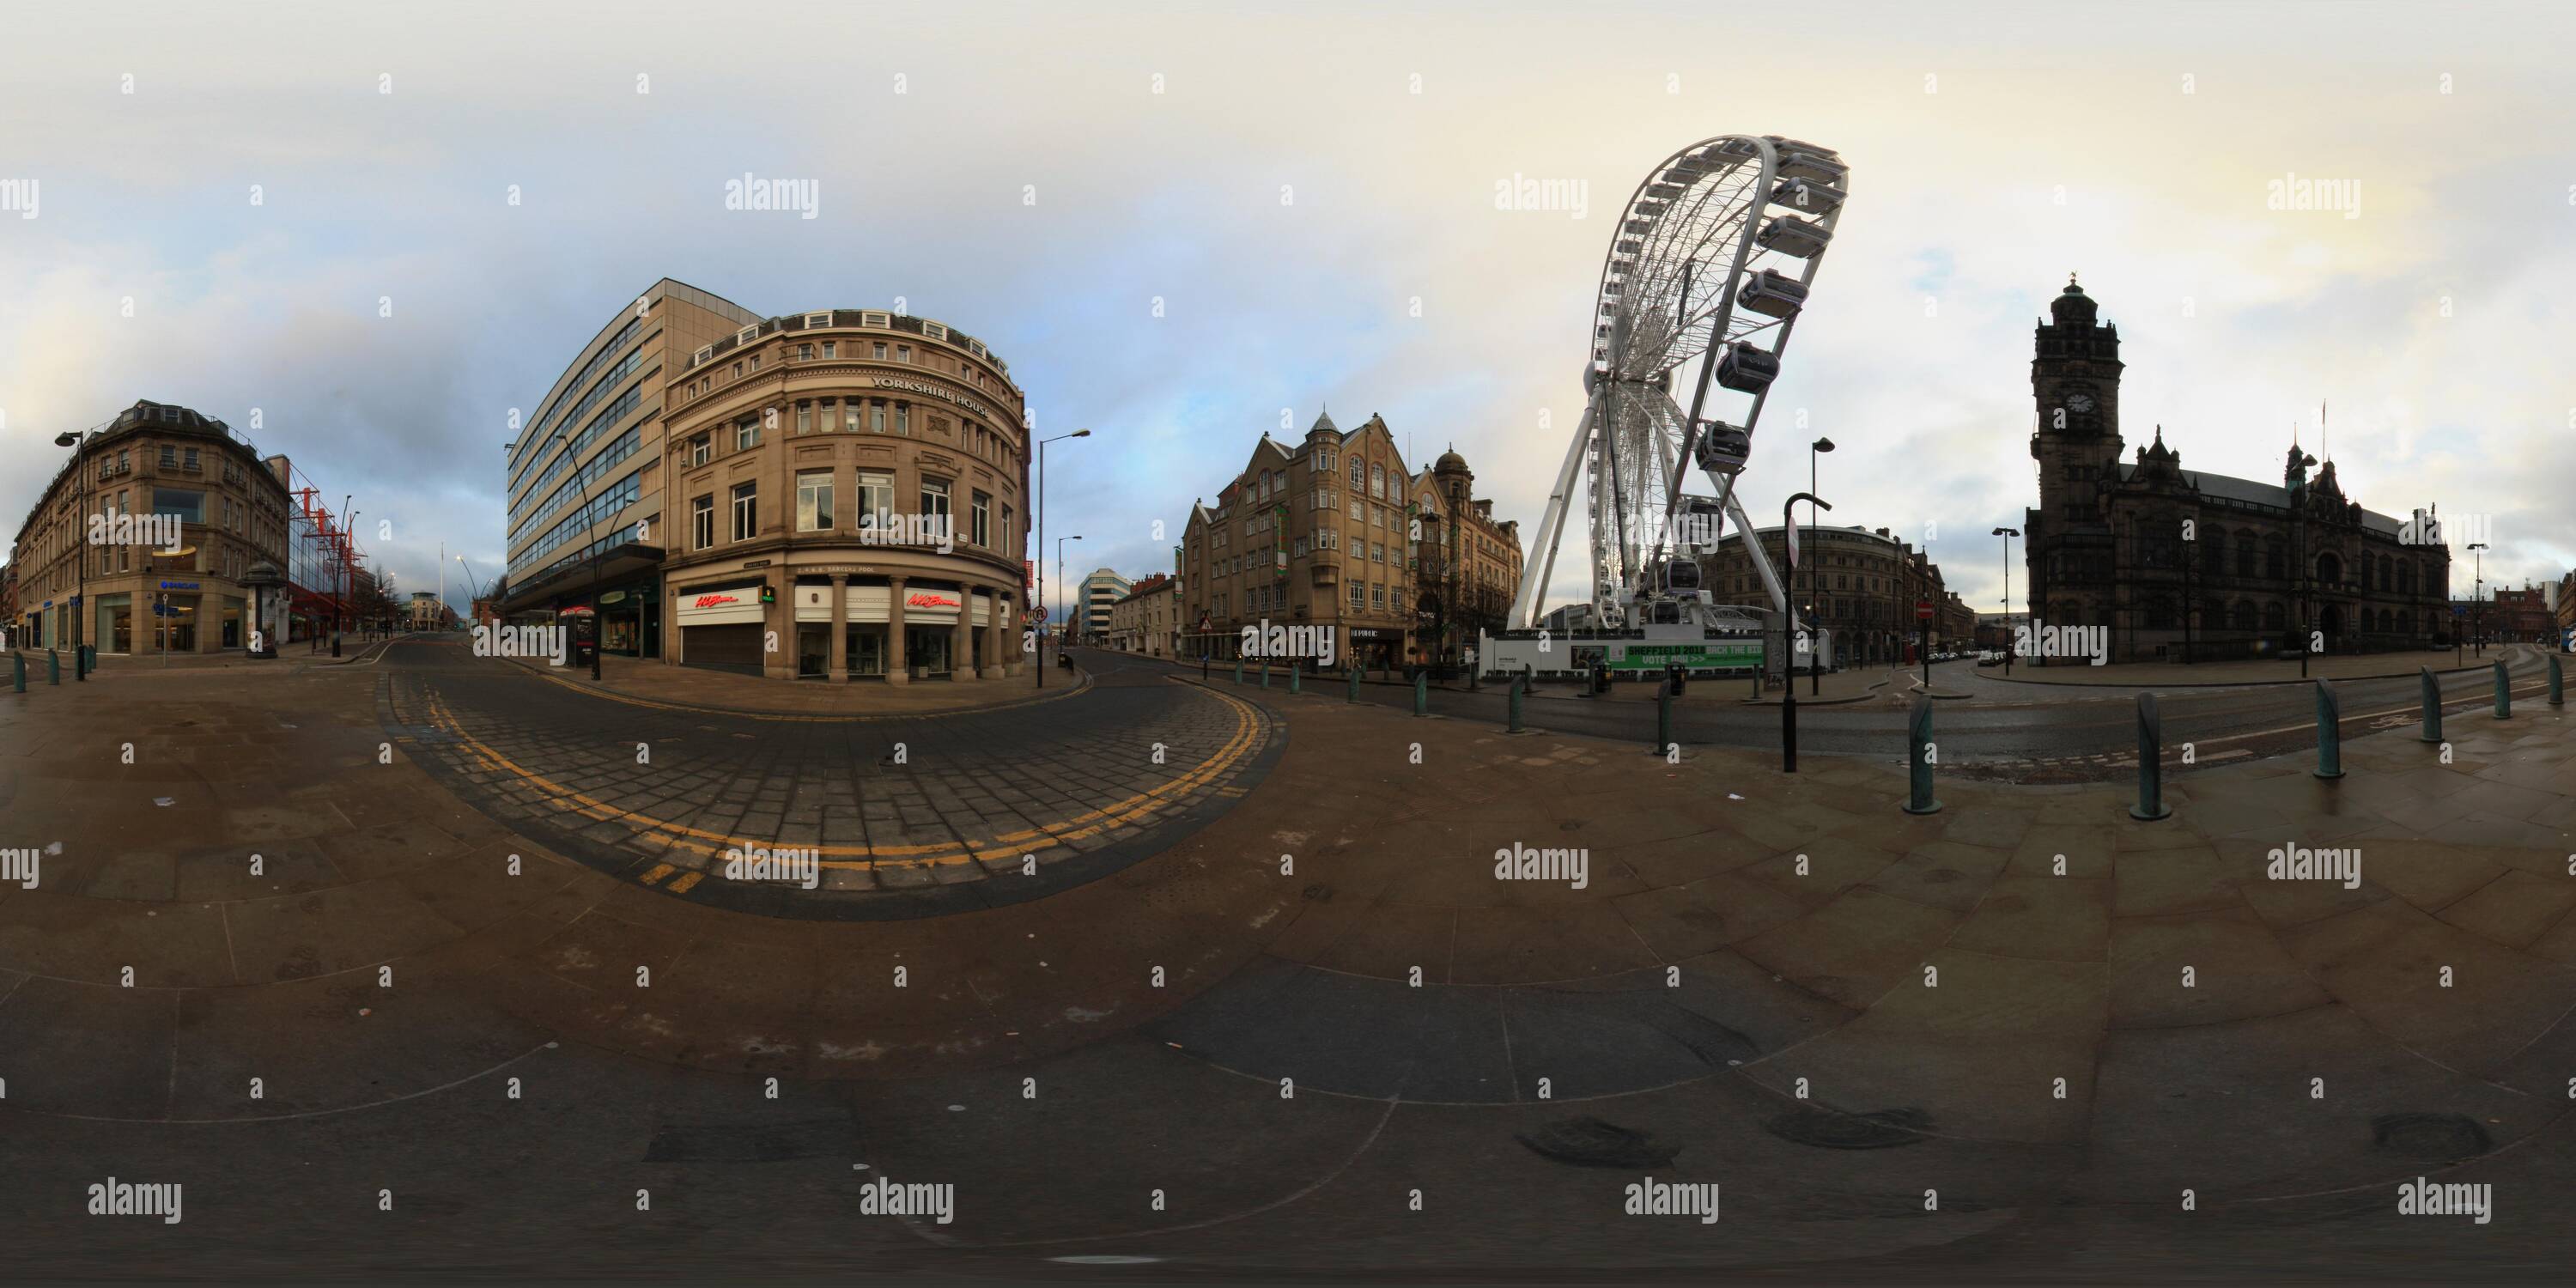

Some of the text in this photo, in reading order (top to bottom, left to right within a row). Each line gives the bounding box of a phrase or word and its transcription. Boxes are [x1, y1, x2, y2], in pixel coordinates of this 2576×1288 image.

[873, 377, 989, 418] YORKSHIRE HOUSE
[1627, 646, 1680, 656] SHEFFIELD
[1706, 646, 1728, 654] BACK
[1730, 645, 1745, 653] THE
[1642, 655, 1666, 664] VOTE
